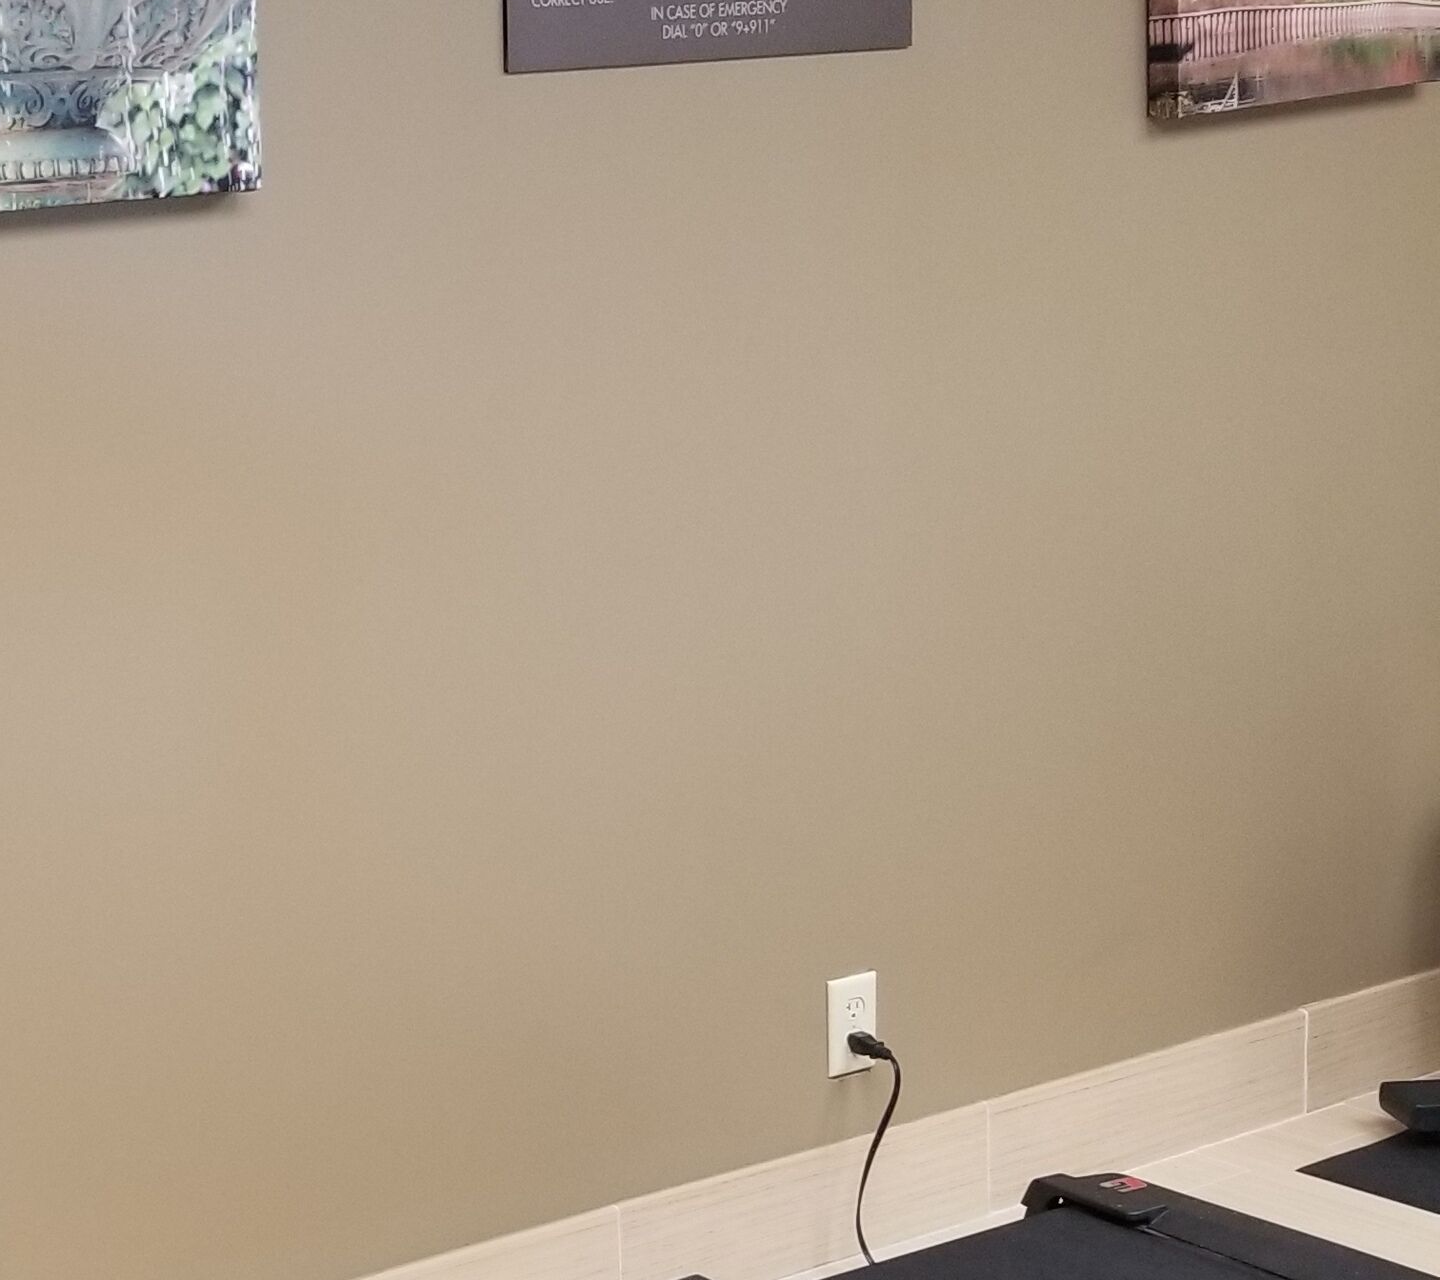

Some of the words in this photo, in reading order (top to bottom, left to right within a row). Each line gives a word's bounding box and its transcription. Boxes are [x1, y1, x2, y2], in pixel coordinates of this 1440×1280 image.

[651, 6, 663, 21] IN
[667, 4, 696, 20] CASE
[699, 3, 715, 17] OF
[718, 0, 788, 17] EMERGENCY
[662, 24, 688, 39] DIAL
[711, 23, 728, 36] OR
